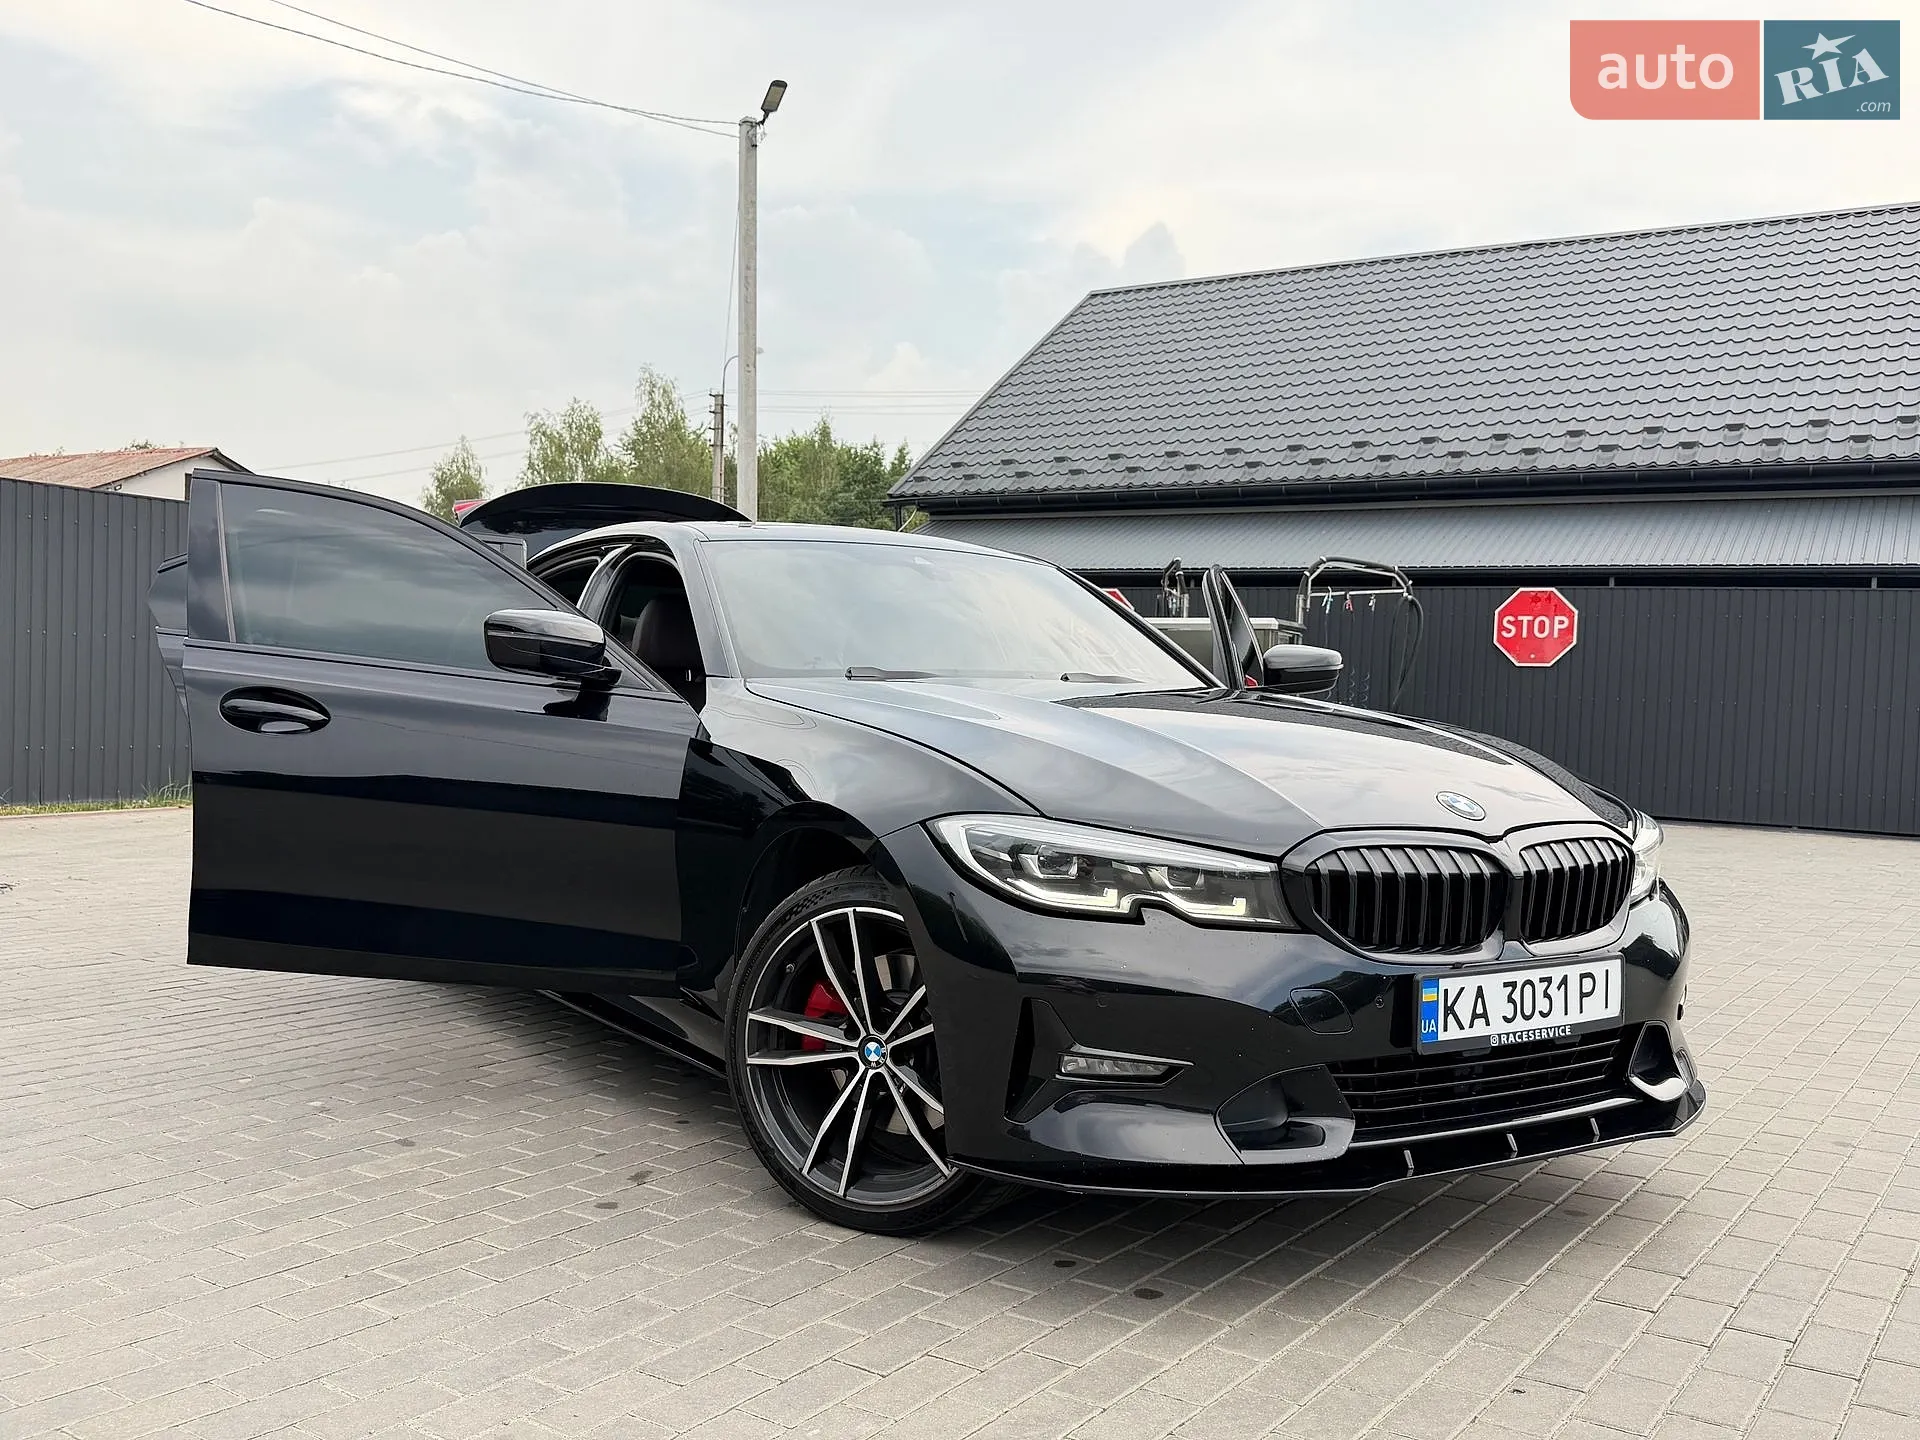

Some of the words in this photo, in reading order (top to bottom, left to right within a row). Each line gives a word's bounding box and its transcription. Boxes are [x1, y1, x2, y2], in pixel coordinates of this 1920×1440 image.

[1501, 615, 1569, 639] STOP
[1442, 985, 1491, 1033] KA
[1501, 973, 1569, 1024] 3031
[1421, 1018, 1437, 1034] UA
[1500, 1025, 1572, 1045] RACESERVICE
